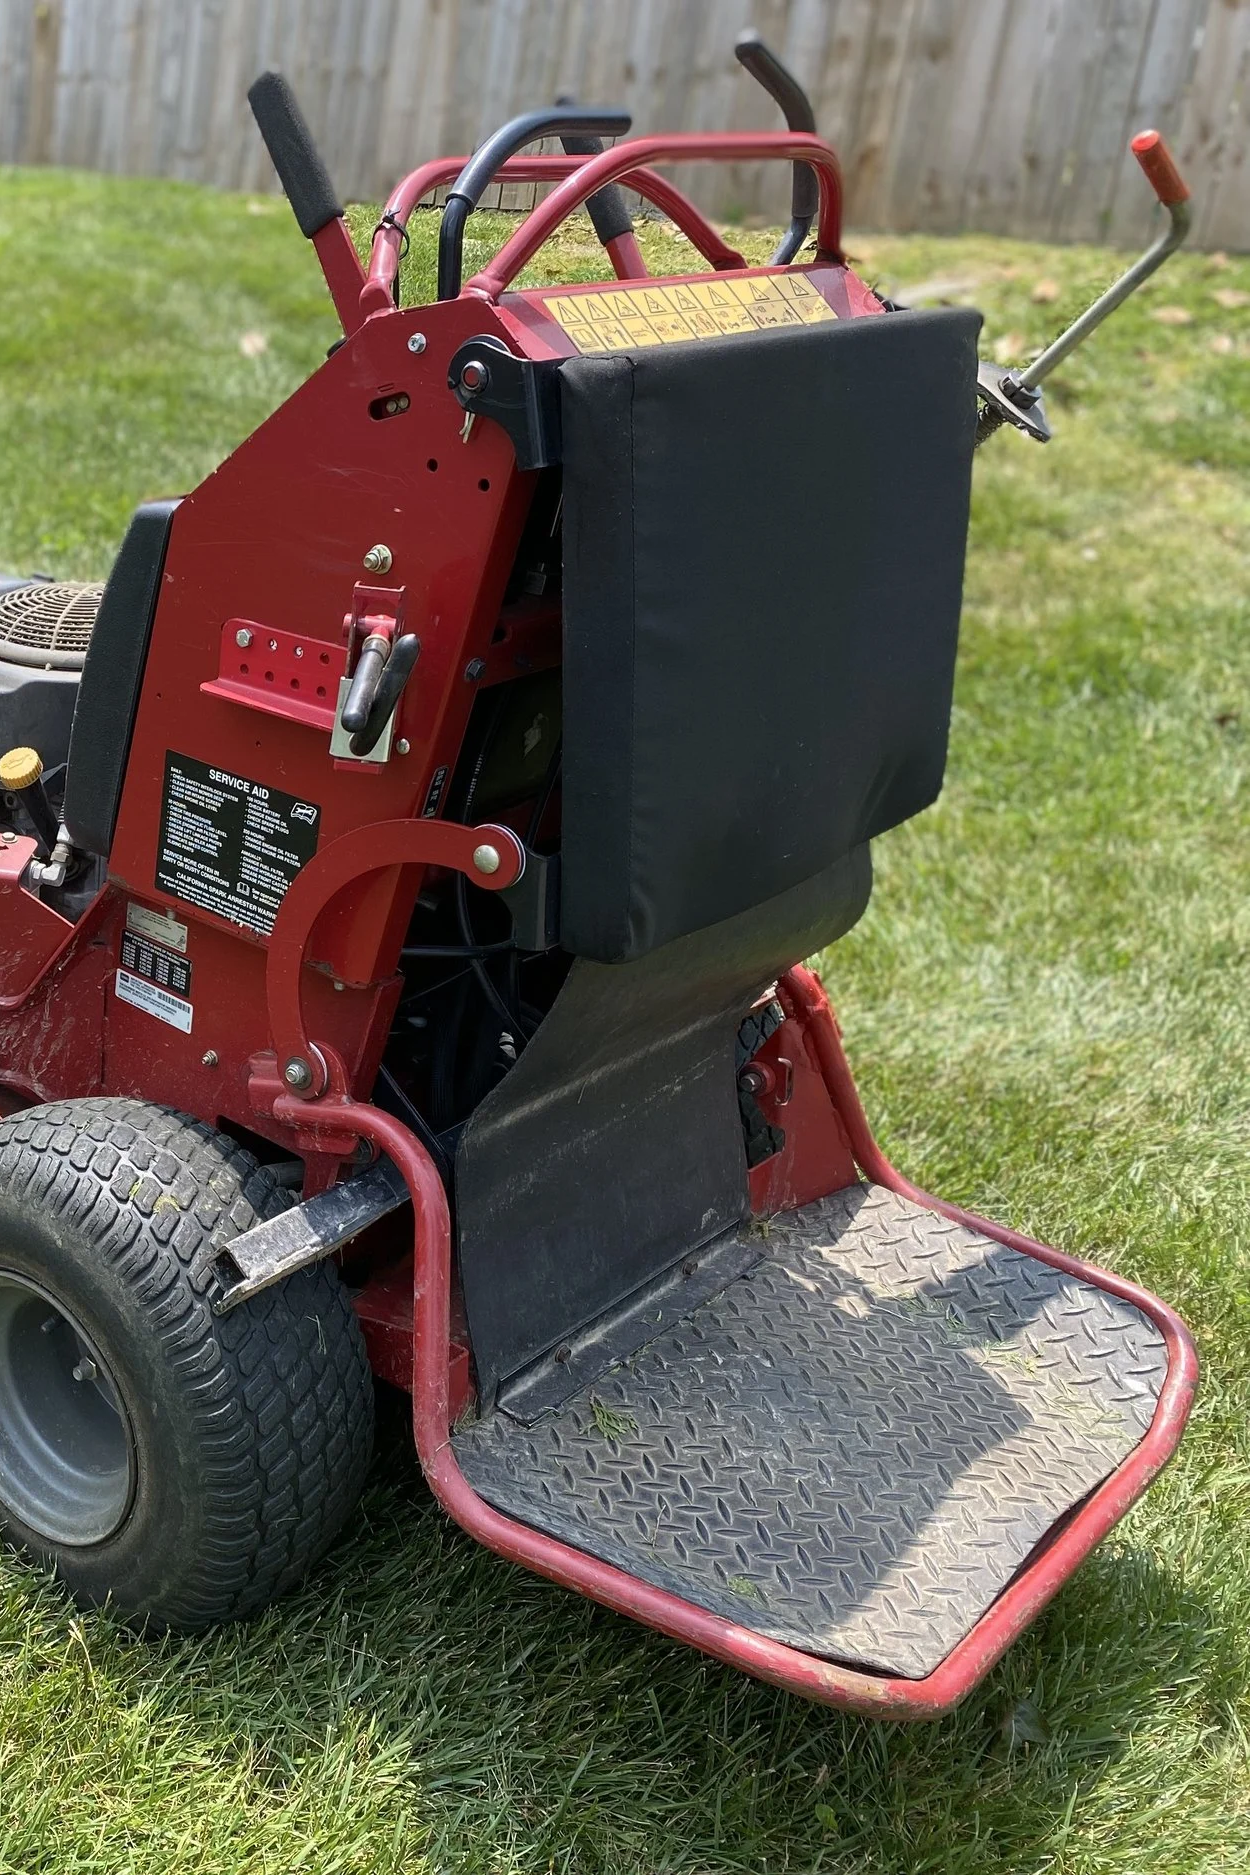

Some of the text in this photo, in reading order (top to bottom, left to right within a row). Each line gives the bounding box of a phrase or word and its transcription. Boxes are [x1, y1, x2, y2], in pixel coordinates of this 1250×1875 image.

[172, 779, 224, 803] CLEAN UNDER MOWER DECK
[173, 773, 239, 802] CHECK SAFETY INTERLOCK SYSTEM
[209, 768, 269, 800] SERVICE AID
[171, 790, 184, 799] CHECK
[185, 795, 198, 805] ENGINE
[206, 803, 218, 813] LEVEL
[172, 785, 184, 793] CLEAN
[192, 792, 205, 801] INTAKE
[206, 798, 221, 808] SCREEN
[170, 805, 182, 814] CHECK
[192, 814, 212, 825] PRESSURE
[248, 802, 281, 819] CHECK BATTERY
[248, 808, 264, 819] CHANGE
[265, 815, 280, 825] ENGINE
[169, 816, 181, 825] CHECK
[182, 821, 196, 831] ENGINE
[204, 830, 219, 840] FILTERS
[170, 810, 228, 838] CHECK HYDRAULIC FLUID LEVEL
[247, 814, 289, 835] CHECK SPARK PLUGS
[247, 820, 273, 835] CHECK BELTS
[168, 833, 219, 857] LUBRICATE SPEED CONTROL
[244, 841, 261, 852] CHANGE
[261, 848, 276, 858] ENGINE
[284, 857, 301, 868] FILTERS
[245, 835, 262, 846] CHANGE
[262, 842, 277, 852] ENGINE
[285, 851, 298, 861] FILTER
[163, 848, 183, 861] SERVICE
[184, 857, 197, 867] MORE
[198, 863, 213, 874] OFTEN
[163, 855, 176, 865] DIRTY
[185, 864, 200, 875] DUSTY
[201, 870, 230, 888] CONDITIONS
[242, 862, 259, 873] CHANGE
[259, 869, 282, 882] HYDRAULIC
[243, 856, 284, 877] CHANGE FUEL FILTER
[177, 872, 208, 891] CALIFORNIA
[209, 885, 227, 898] SPARK
[227, 894, 257, 911] ARRESTER
